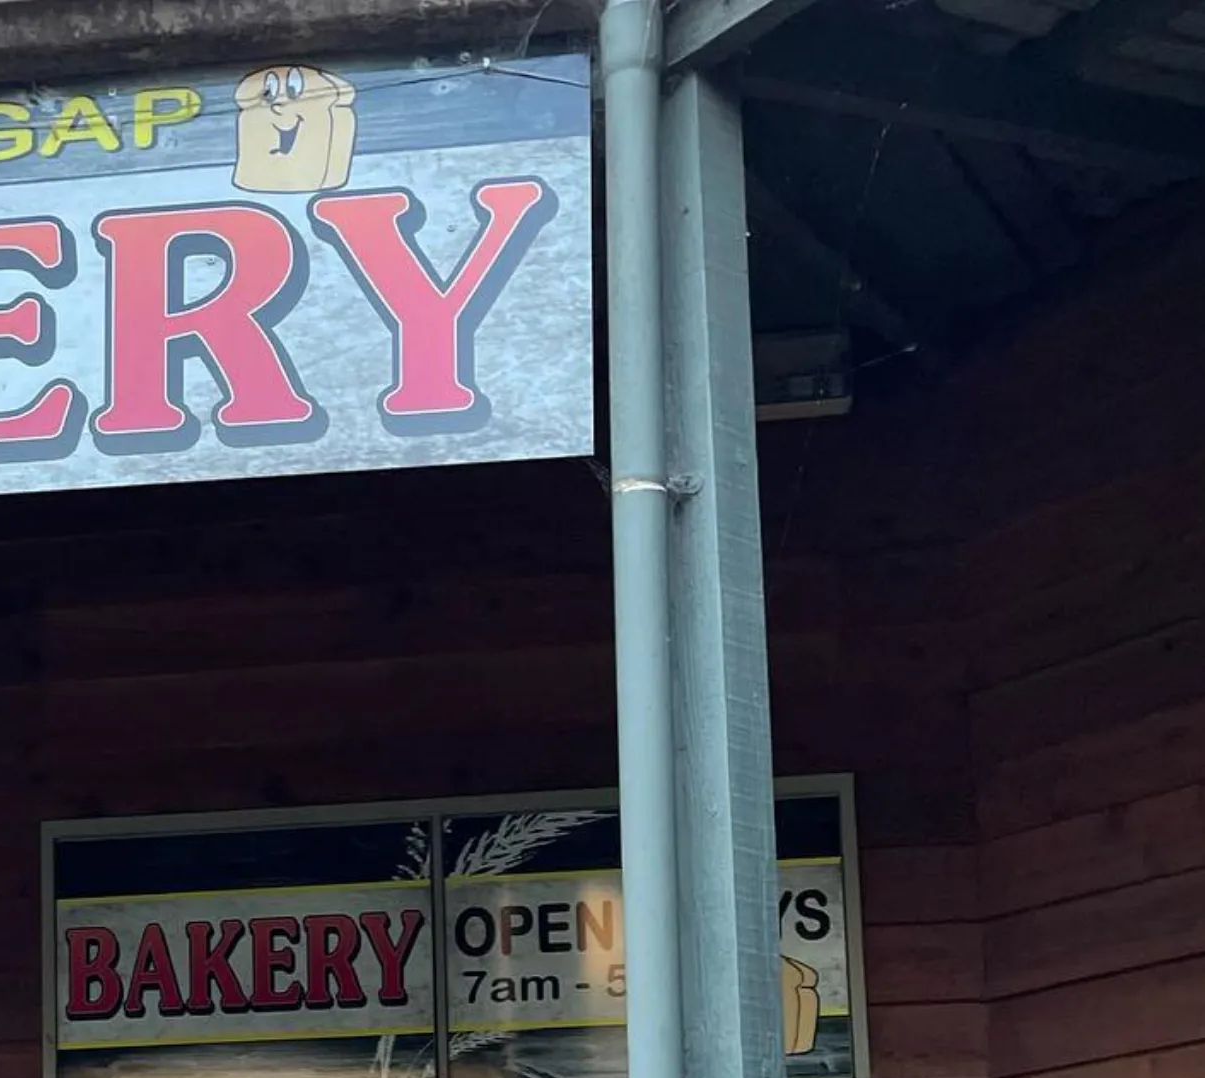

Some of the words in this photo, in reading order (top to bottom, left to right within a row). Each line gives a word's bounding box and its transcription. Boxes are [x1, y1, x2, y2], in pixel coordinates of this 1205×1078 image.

[454, 900, 615, 958] OPEN
[65, 909, 425, 1021] BAKERY
[461, 970, 561, 1005] 7am
